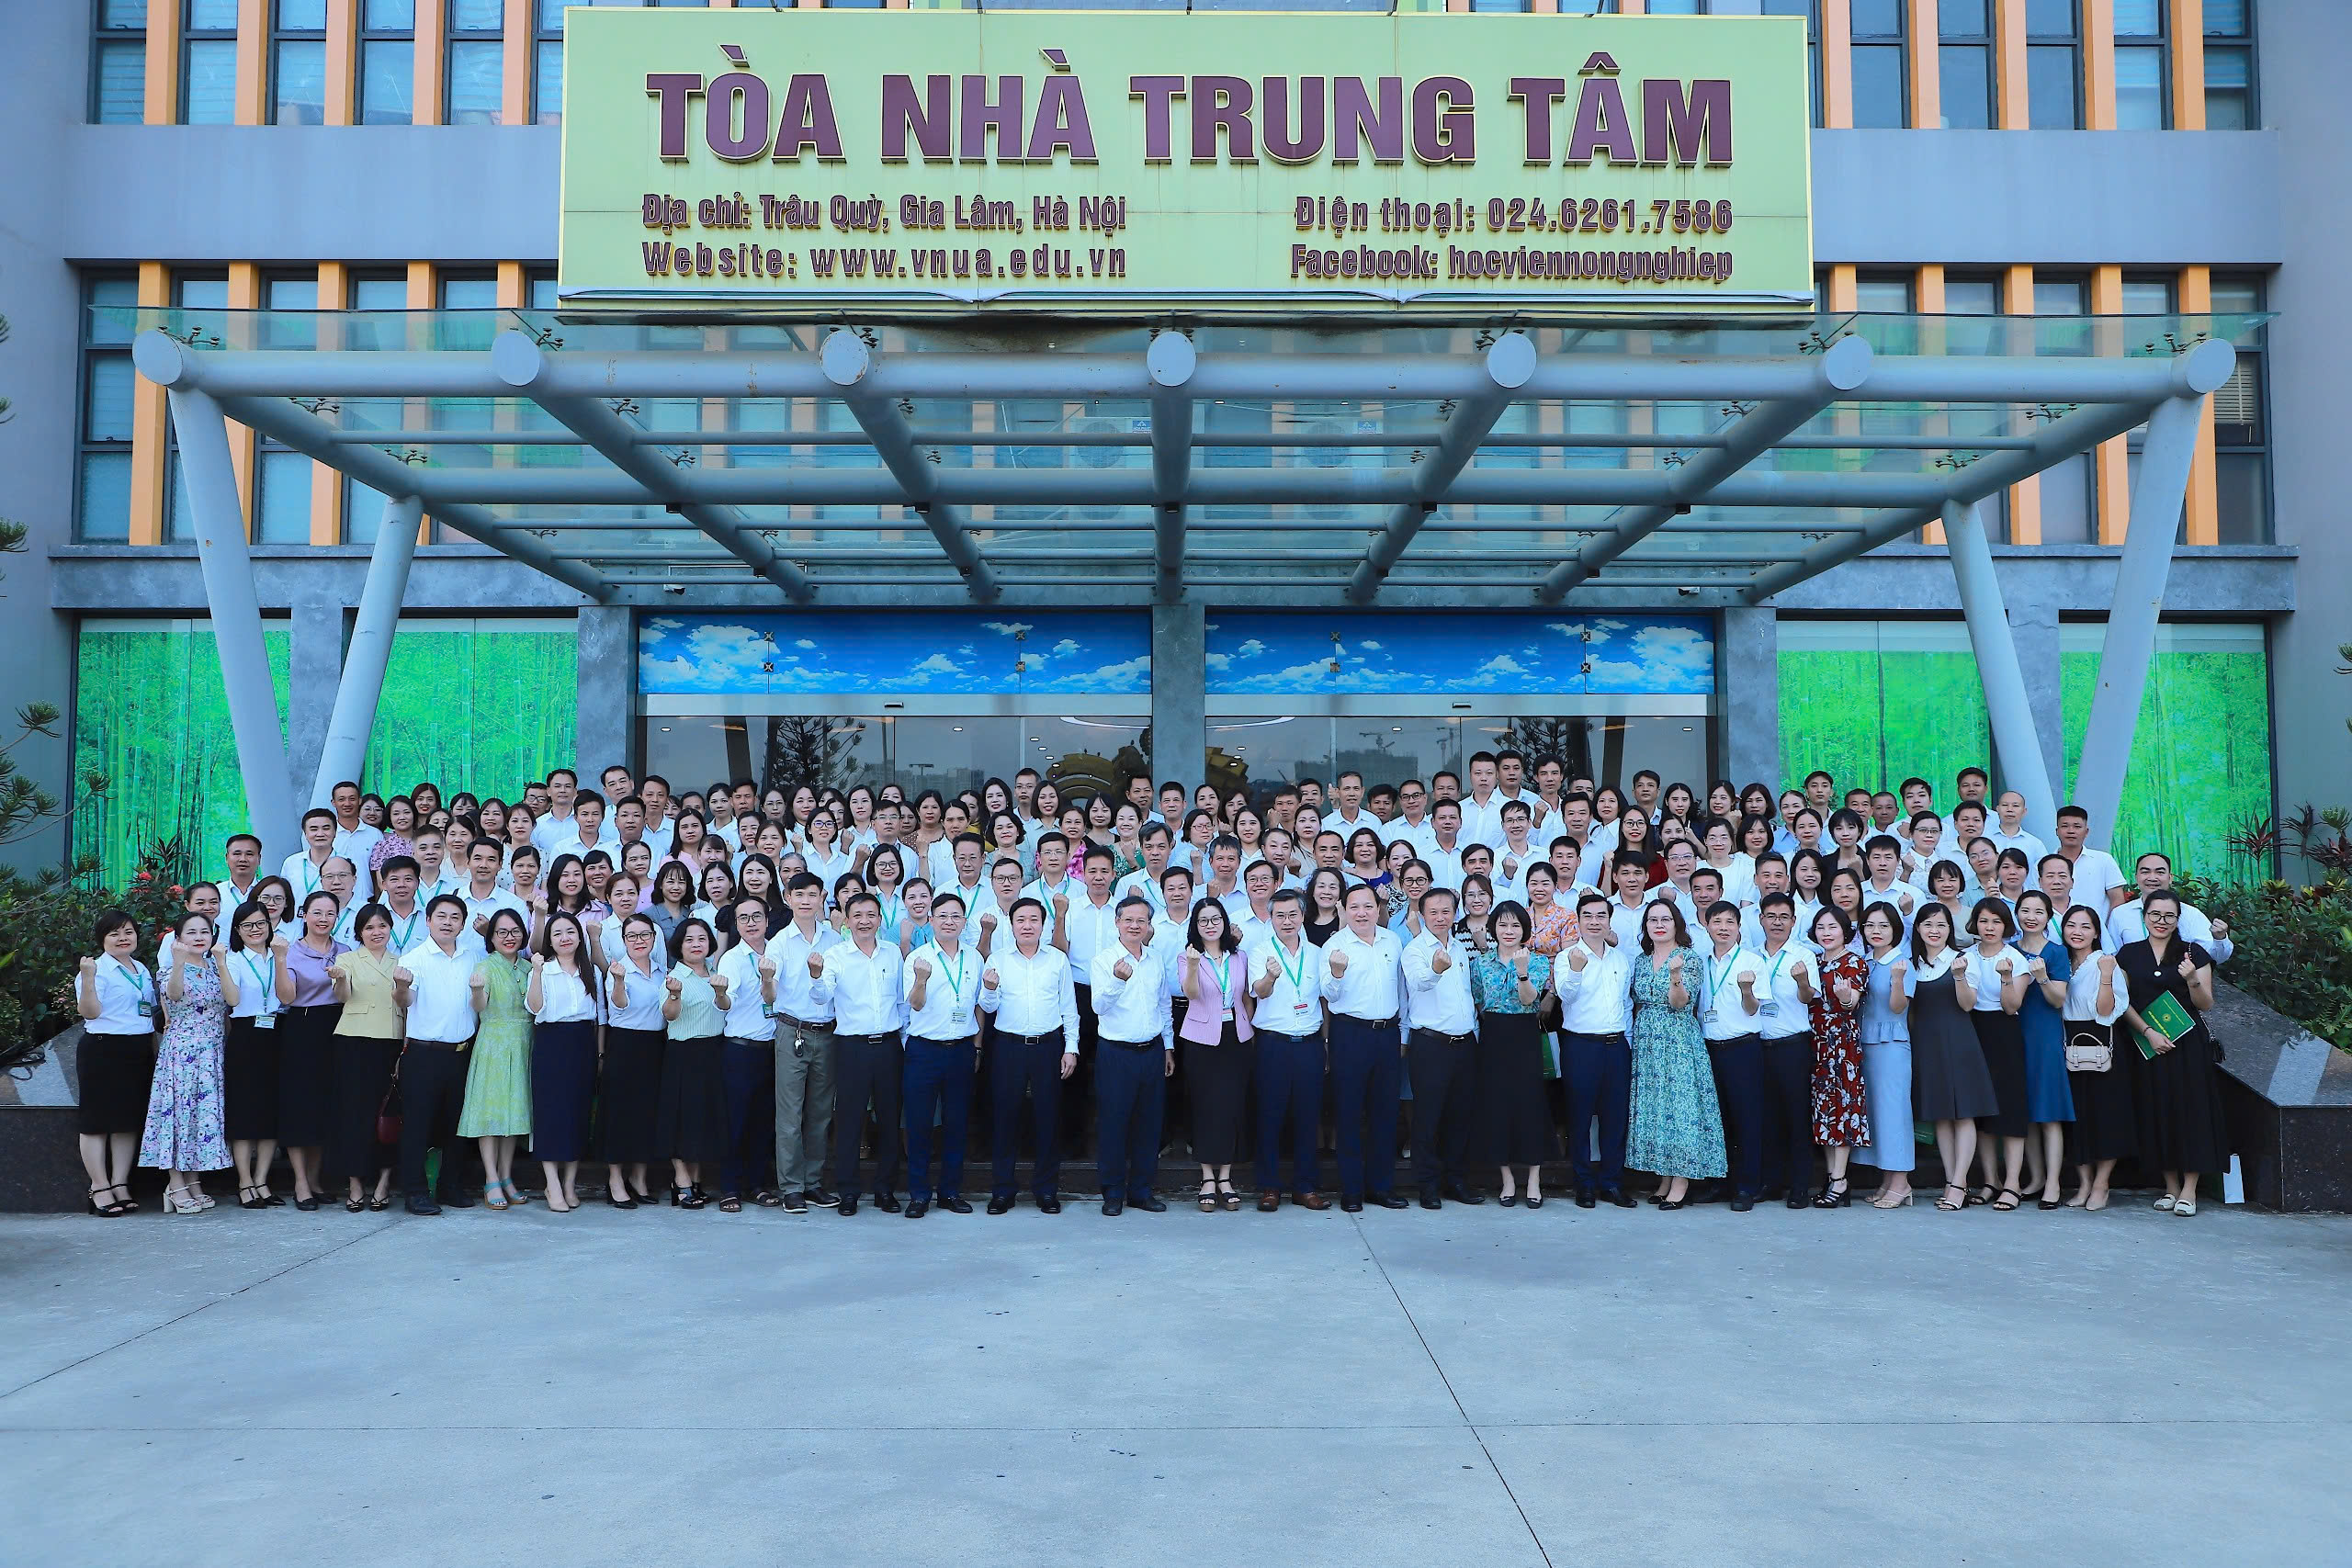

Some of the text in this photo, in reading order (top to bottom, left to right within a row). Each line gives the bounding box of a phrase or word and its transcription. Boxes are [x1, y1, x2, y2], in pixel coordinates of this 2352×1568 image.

[645, 43, 1734, 168] TÒA NHÀ TRUNG TÂM
[642, 192, 1125, 236] Địa chỉ: Trâu Quỳ, Gia Lâm, Hà Nội
[1295, 196, 1734, 238] Điện thoại: 024.6261.7586
[641, 242, 1125, 278] Website: www.vnua.edu.vn
[1291, 244, 1734, 284] Facebook: hocviennongnghiep
